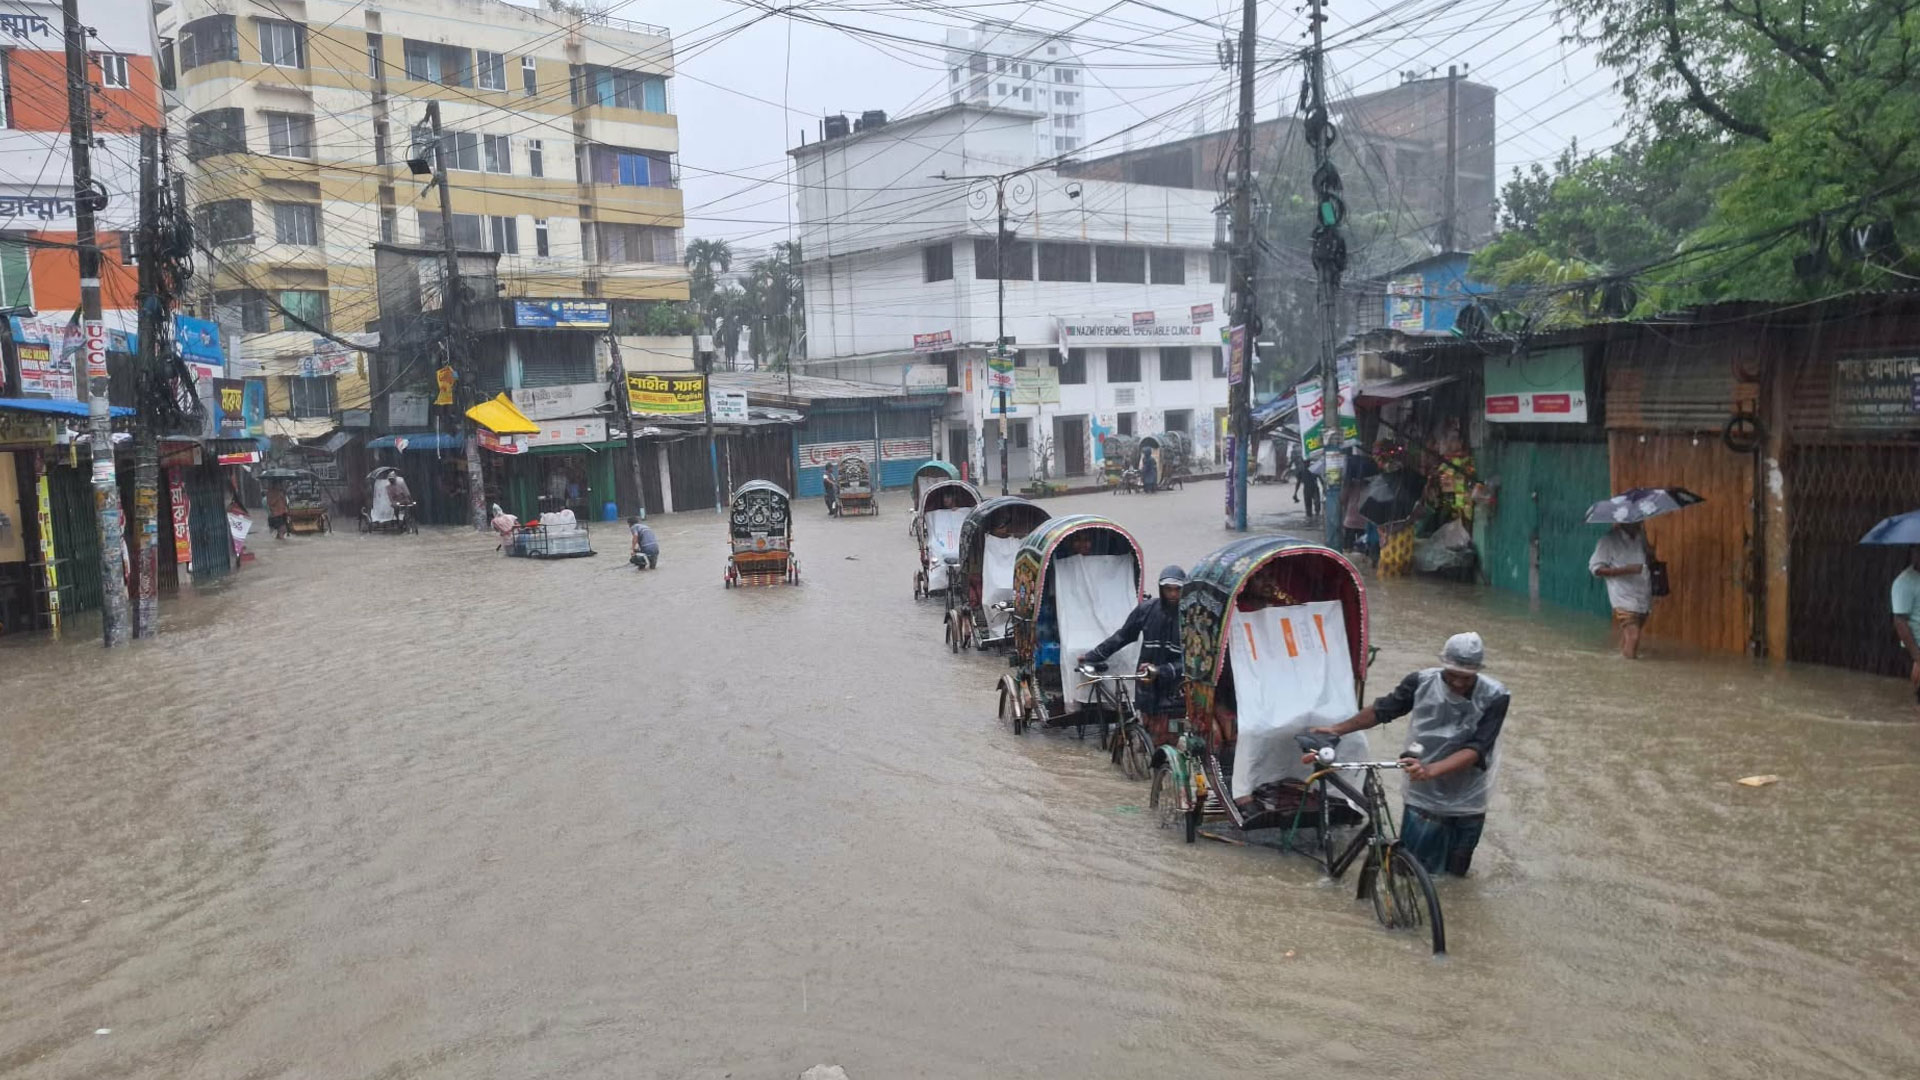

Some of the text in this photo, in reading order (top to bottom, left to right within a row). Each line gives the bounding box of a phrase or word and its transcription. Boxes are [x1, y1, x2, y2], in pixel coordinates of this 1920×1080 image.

[85, 325, 105, 364] UCC
[629, 376, 703, 392] শাহীন স্যার
[676, 393, 703, 402] English
